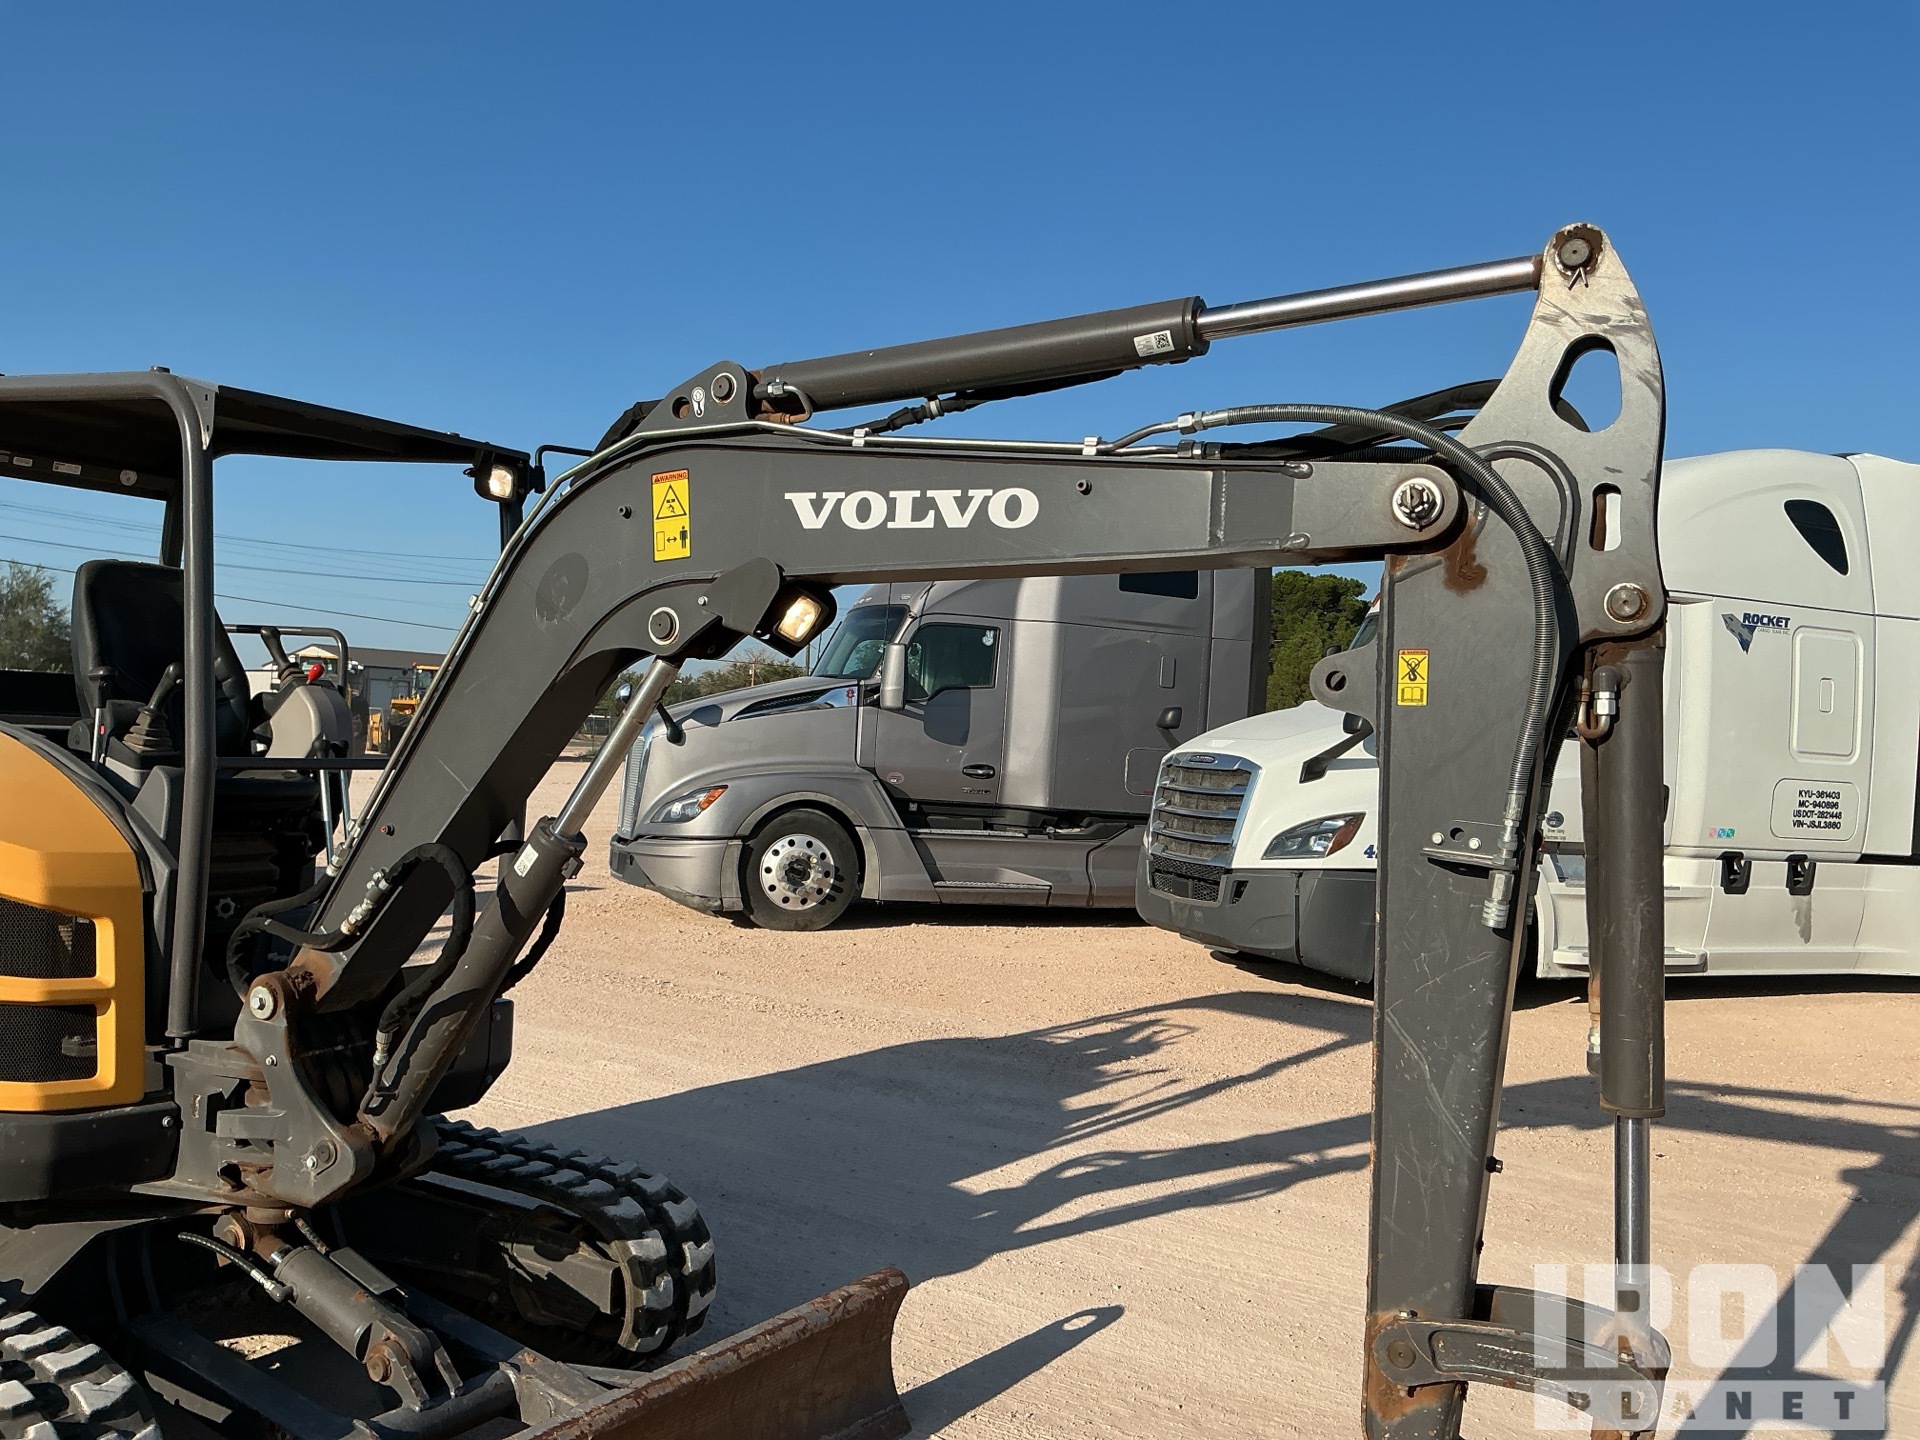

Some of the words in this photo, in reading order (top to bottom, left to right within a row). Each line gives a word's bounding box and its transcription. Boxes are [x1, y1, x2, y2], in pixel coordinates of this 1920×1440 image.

[659, 472, 688, 482] WARNING
[784, 487, 1039, 530] VOLVO
[1742, 612, 1791, 628] ROCKET
